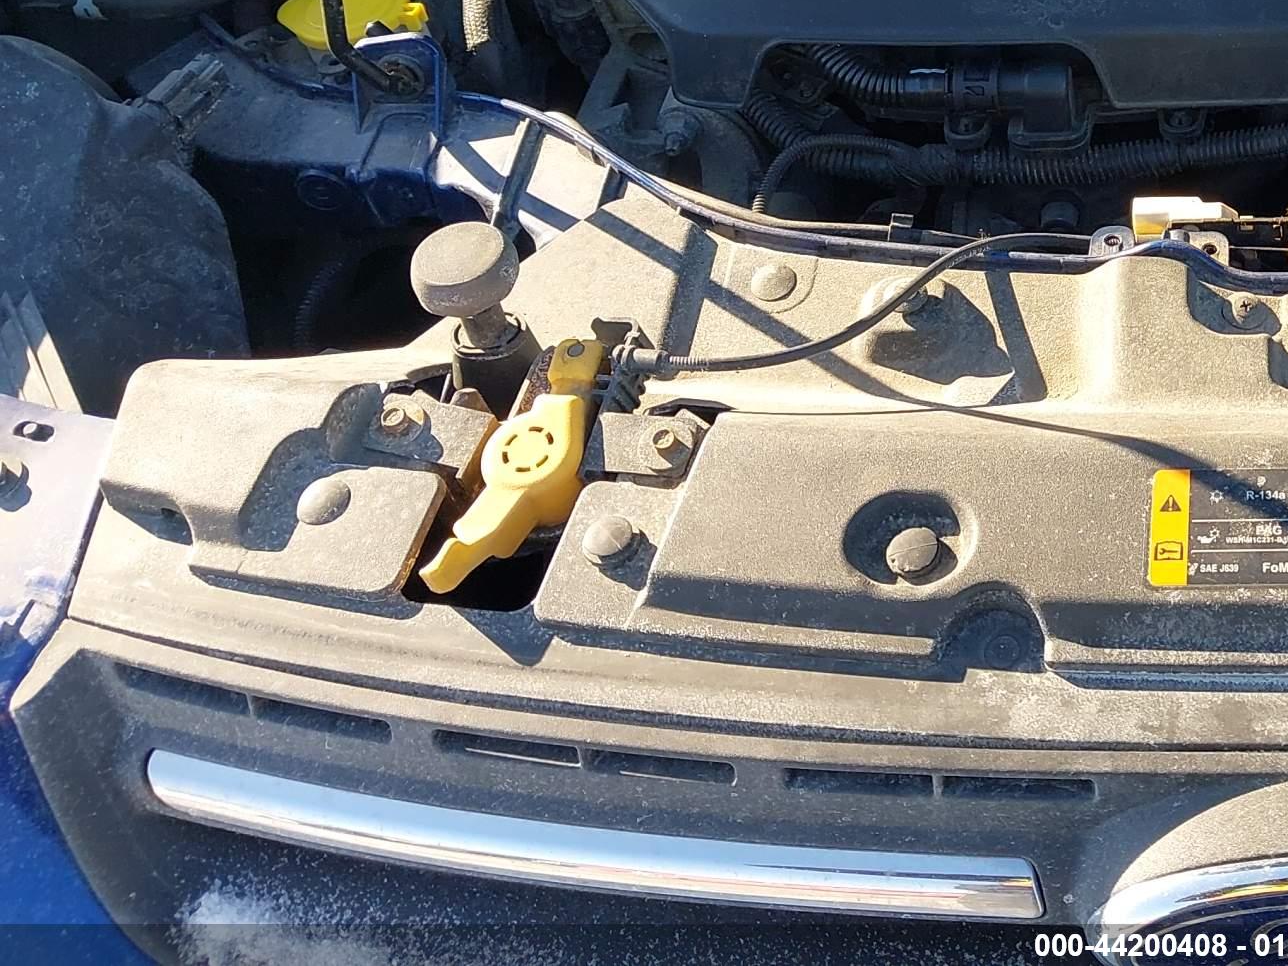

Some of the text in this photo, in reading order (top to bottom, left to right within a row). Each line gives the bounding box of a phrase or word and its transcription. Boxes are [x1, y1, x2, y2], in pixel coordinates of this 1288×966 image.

[1246, 490, 1286, 500] R-134a
[1200, 564, 1239, 573] SAE J639
